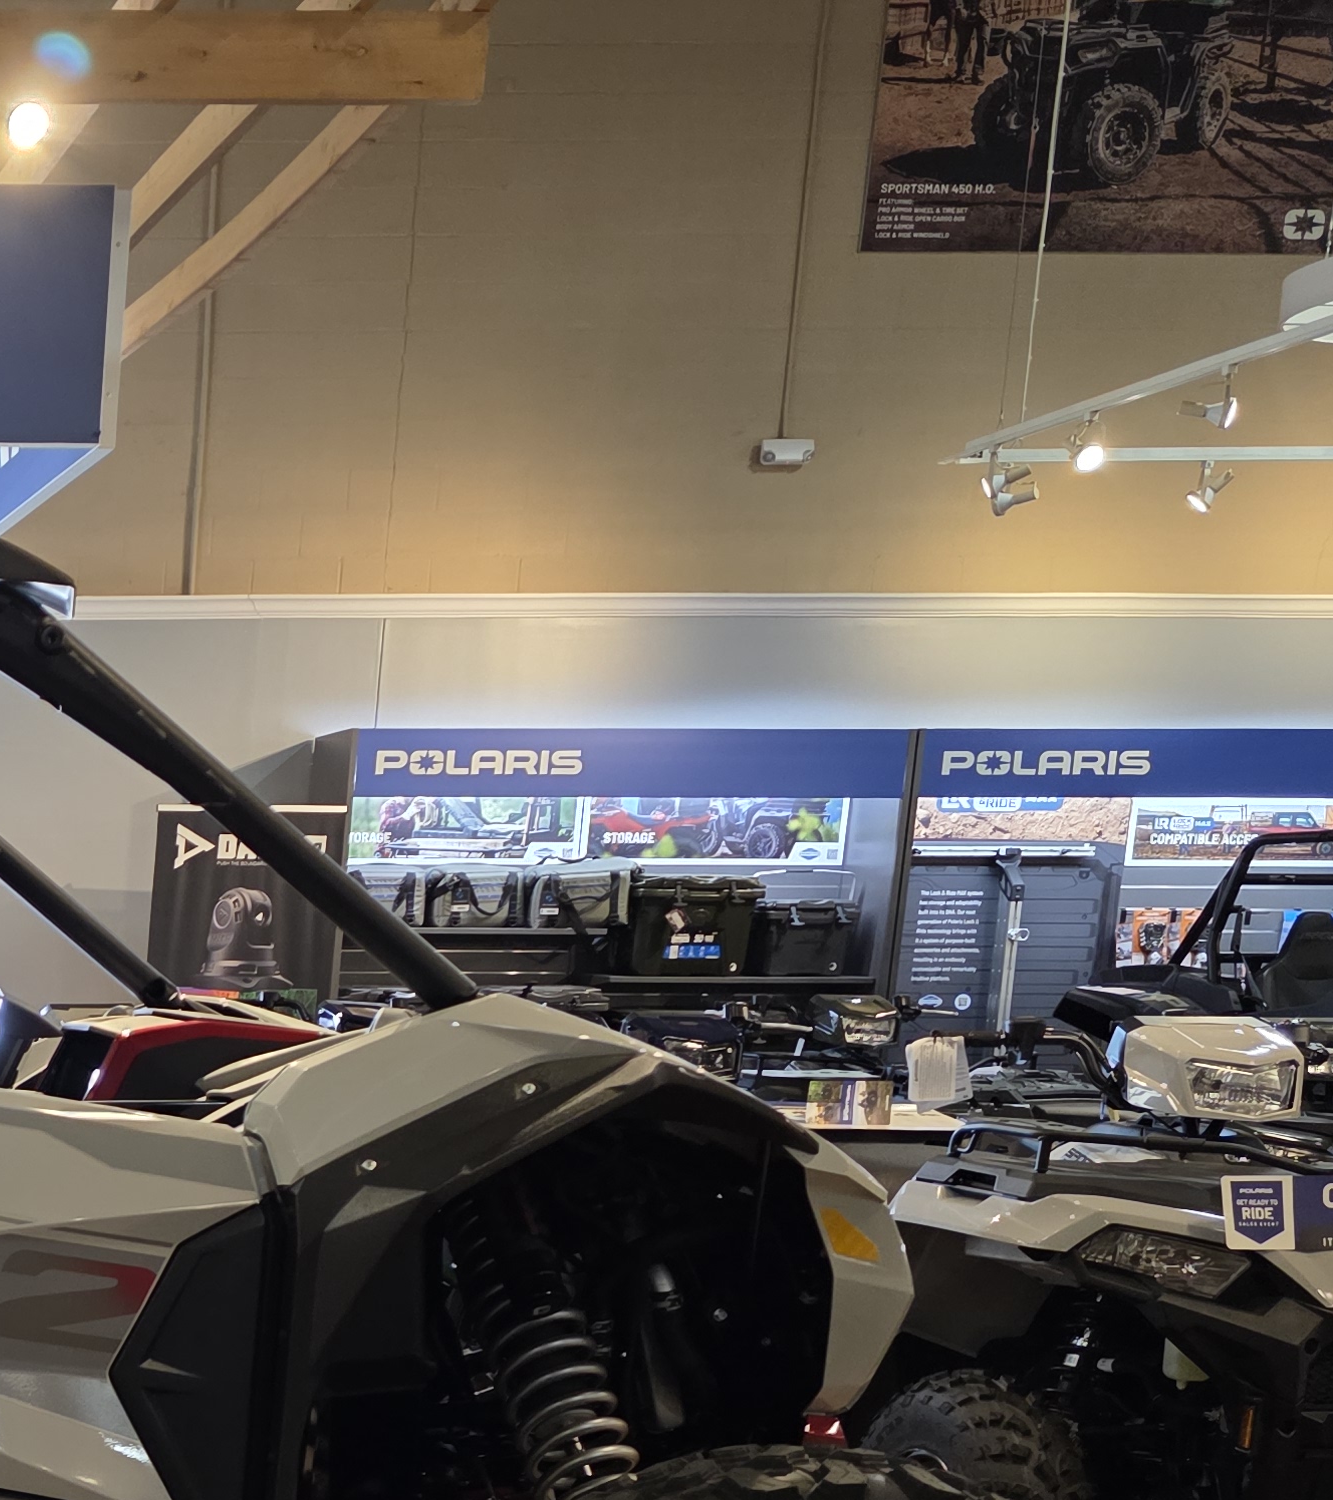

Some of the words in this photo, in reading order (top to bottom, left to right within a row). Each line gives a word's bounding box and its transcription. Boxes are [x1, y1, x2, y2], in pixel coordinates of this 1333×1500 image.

[880, 183, 949, 194] SPORTSMAN
[951, 183, 973, 194] 450
[975, 183, 996, 194] H.O.
[374, 749, 583, 776] POLARIS
[941, 749, 1151, 776] POLARIS
[349, 831, 392, 844] TORAGE
[602, 831, 656, 844] STORAGE
[1149, 832, 1220, 845] COMPATIBLE
[1241, 1207, 1275, 1220] RIDE
